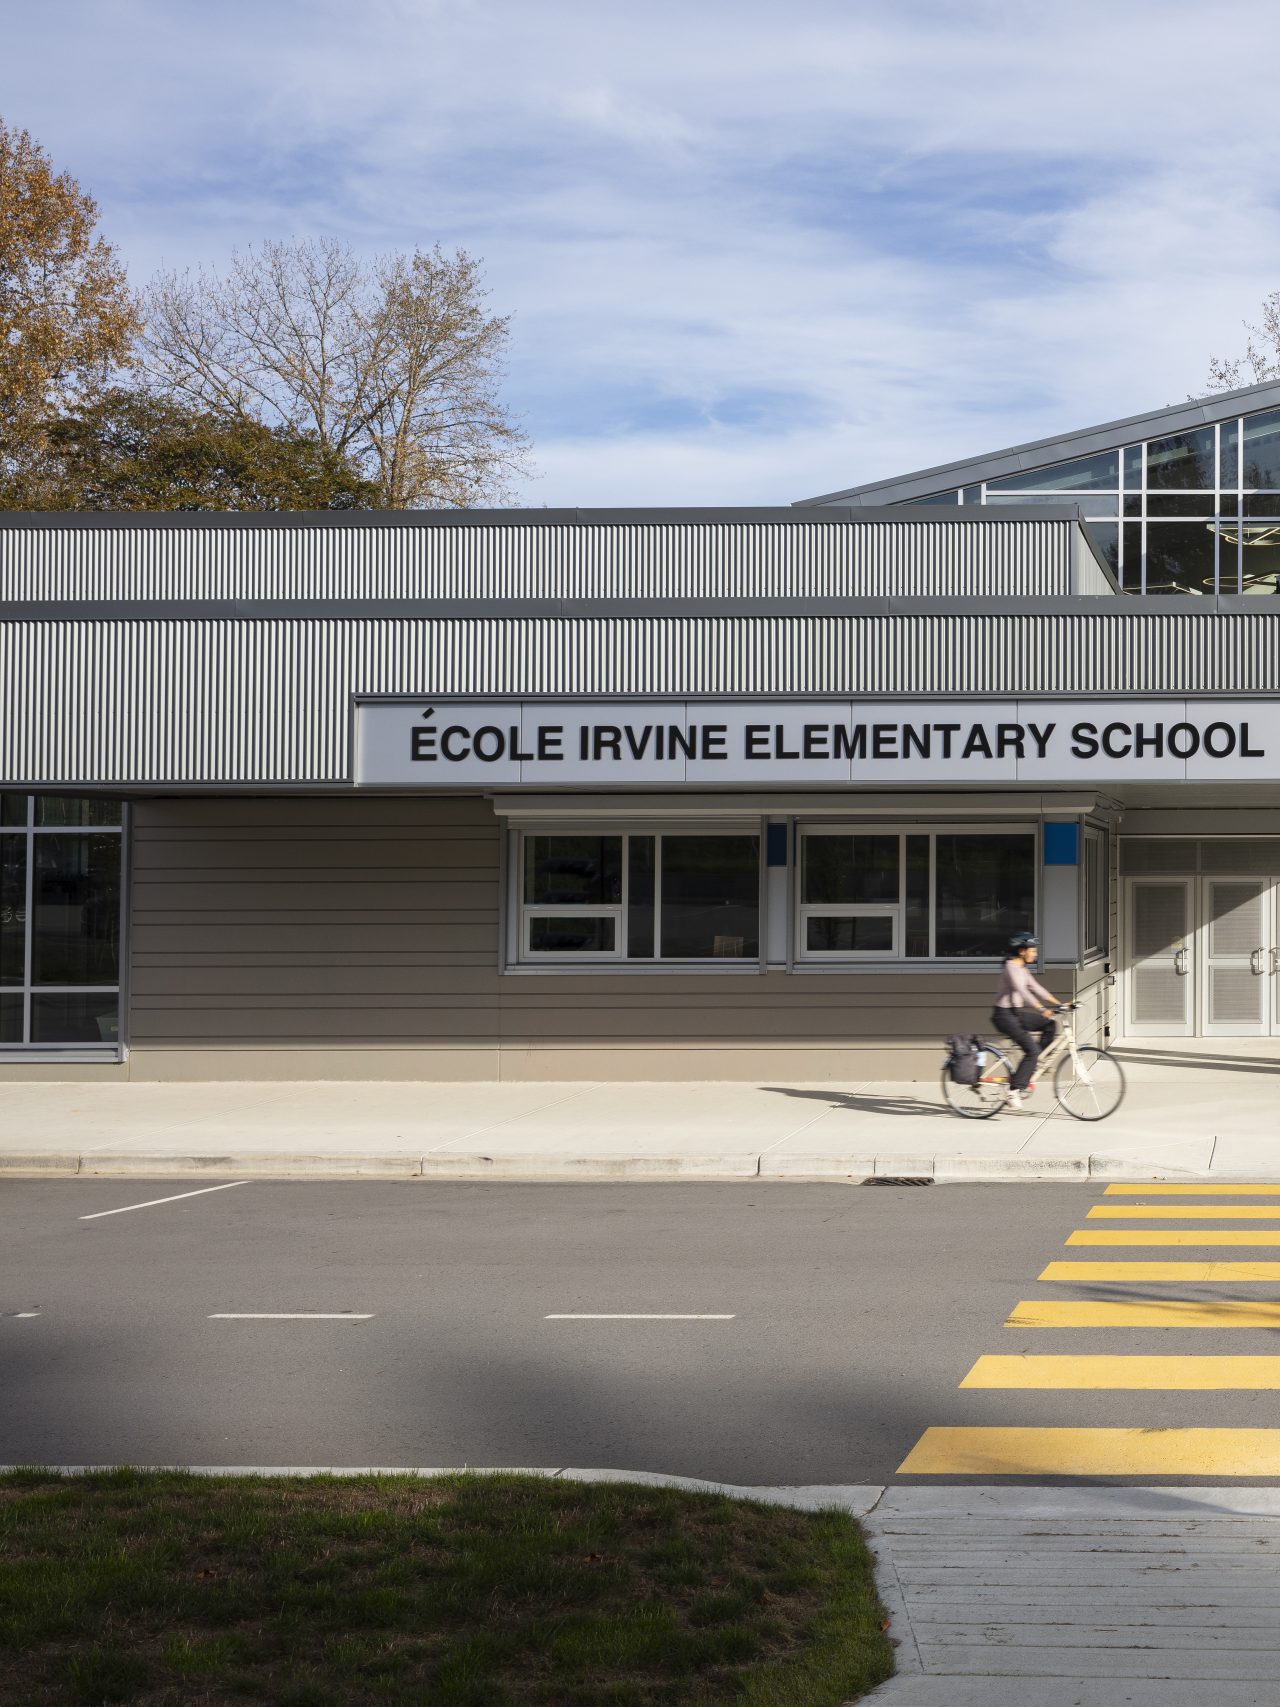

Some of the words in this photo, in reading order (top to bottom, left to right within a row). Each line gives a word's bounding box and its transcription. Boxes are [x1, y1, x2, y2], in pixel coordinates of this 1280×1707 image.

[411, 706, 564, 763] ÉCOLE
[580, 725, 728, 761] IRVINE
[745, 723, 1056, 760] ELEMENTARY
[1071, 722, 1265, 760] SCHOOL
